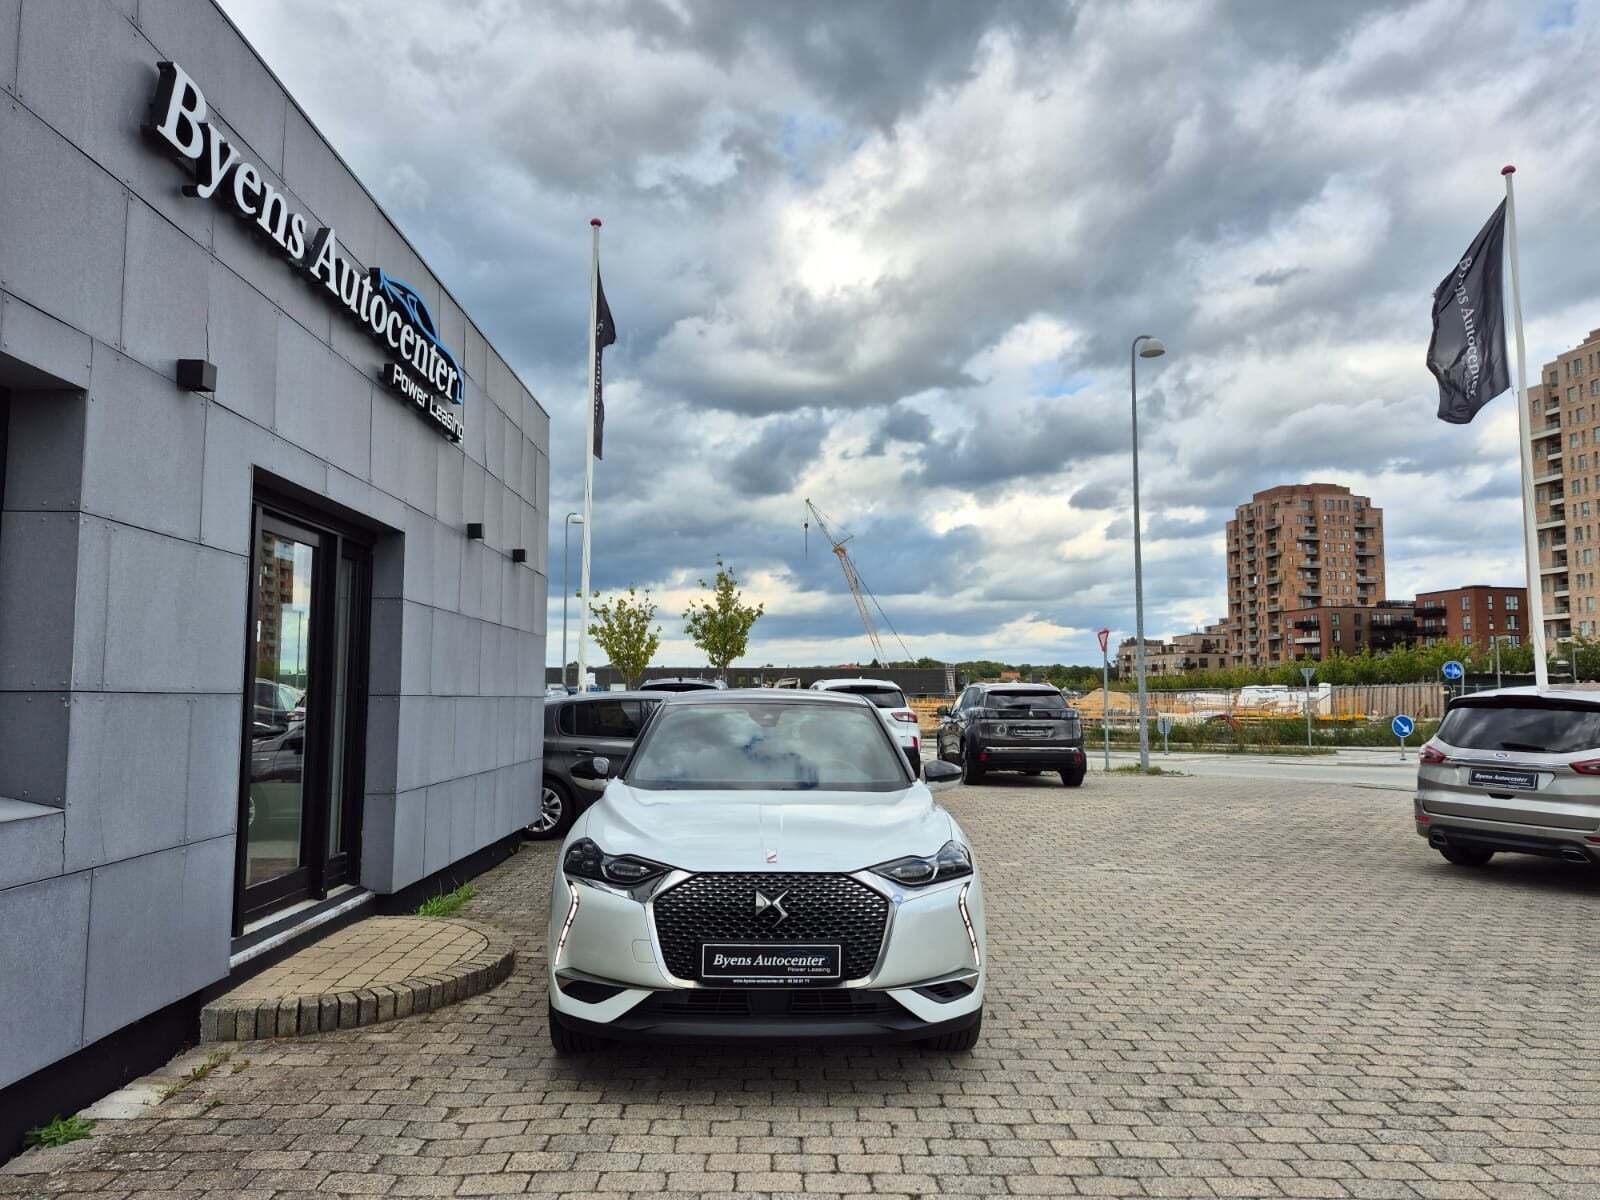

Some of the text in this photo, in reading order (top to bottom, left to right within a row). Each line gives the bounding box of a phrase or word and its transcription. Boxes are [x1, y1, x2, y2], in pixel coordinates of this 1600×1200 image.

[157, 61, 457, 399] Byens Autocenter
[393, 363, 464, 443] Power Leasing
[713, 954, 825, 968] Byens Autocenter
